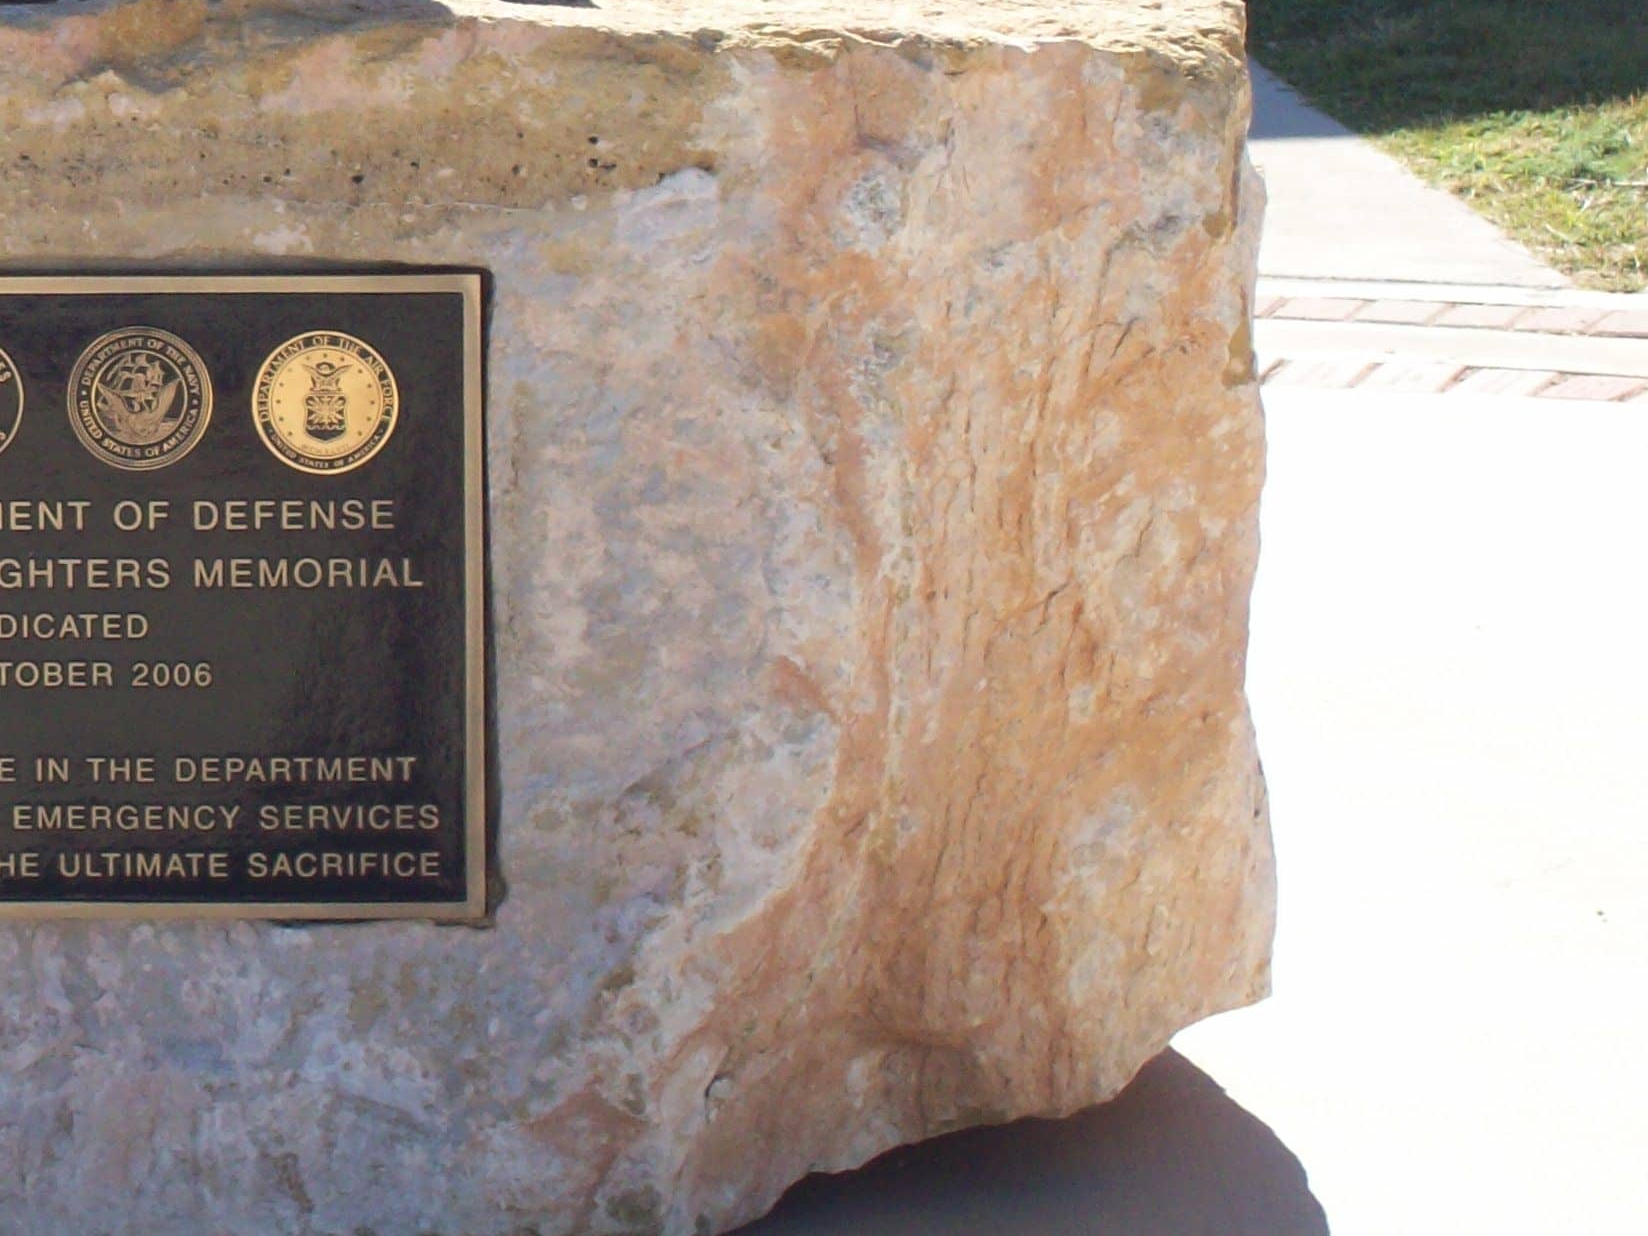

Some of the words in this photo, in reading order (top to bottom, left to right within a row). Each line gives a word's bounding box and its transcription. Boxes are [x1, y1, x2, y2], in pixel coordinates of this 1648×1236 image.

[81, 337, 144, 386] DEPARTMENT
[147, 338, 164, 349] OF
[166, 344, 187, 365] THE
[258, 339, 305, 423] DEPARTMENT
[312, 336, 330, 347] OF
[339, 337, 364, 355] THE
[363, 353, 385, 376] AIR
[145, 446, 161, 457] OF
[113, 500, 170, 531] OF
[193, 499, 395, 531] DEFENSE
[193, 557, 424, 588] MEMORIAL
[131, 662, 212, 687] 2006
[36, 758, 69, 782] IN
[85, 757, 155, 783] THE
[175, 756, 416, 782] DEPARTMENT
[13, 805, 240, 830] EMERGENCY
[260, 804, 440, 830] SERVICES
[59, 852, 228, 878] ULTIMATE
[249, 852, 439, 878] SACRIFICE
